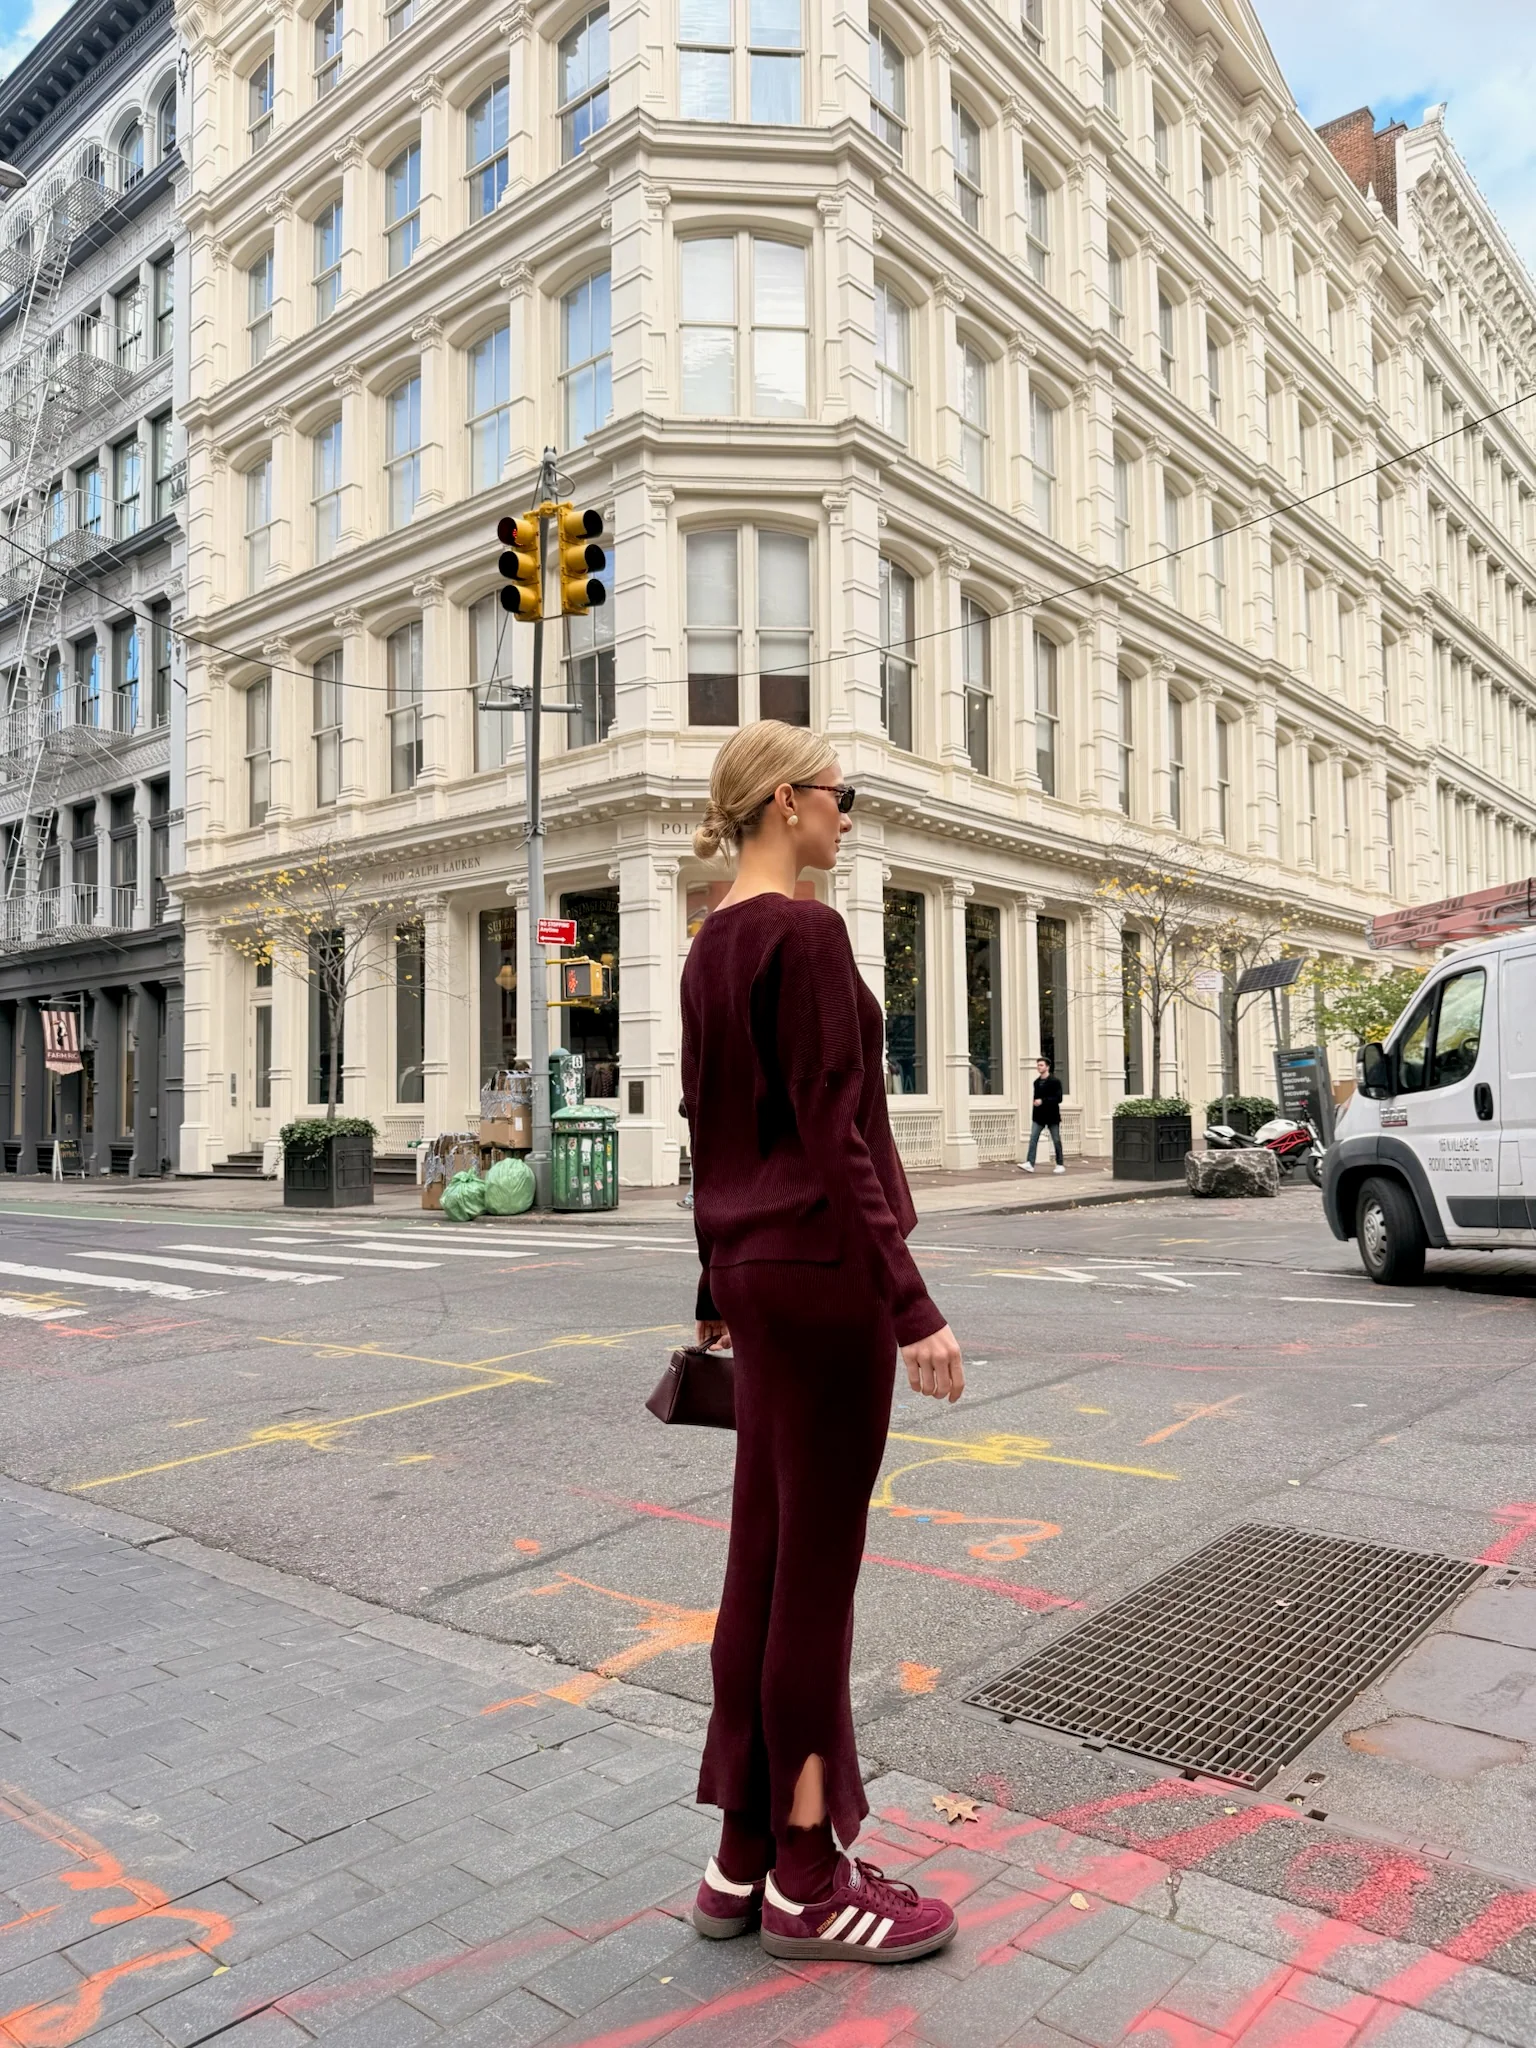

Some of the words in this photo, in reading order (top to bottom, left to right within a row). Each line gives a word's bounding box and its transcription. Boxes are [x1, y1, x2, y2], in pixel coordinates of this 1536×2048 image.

[382, 871, 405, 883] POLO
[409, 864, 439, 878] RALPH
[443, 857, 481, 873] LAUREN
[548, 921, 570, 929] STOPPING
[1428, 1157, 1453, 1172] ROCKVILLE
